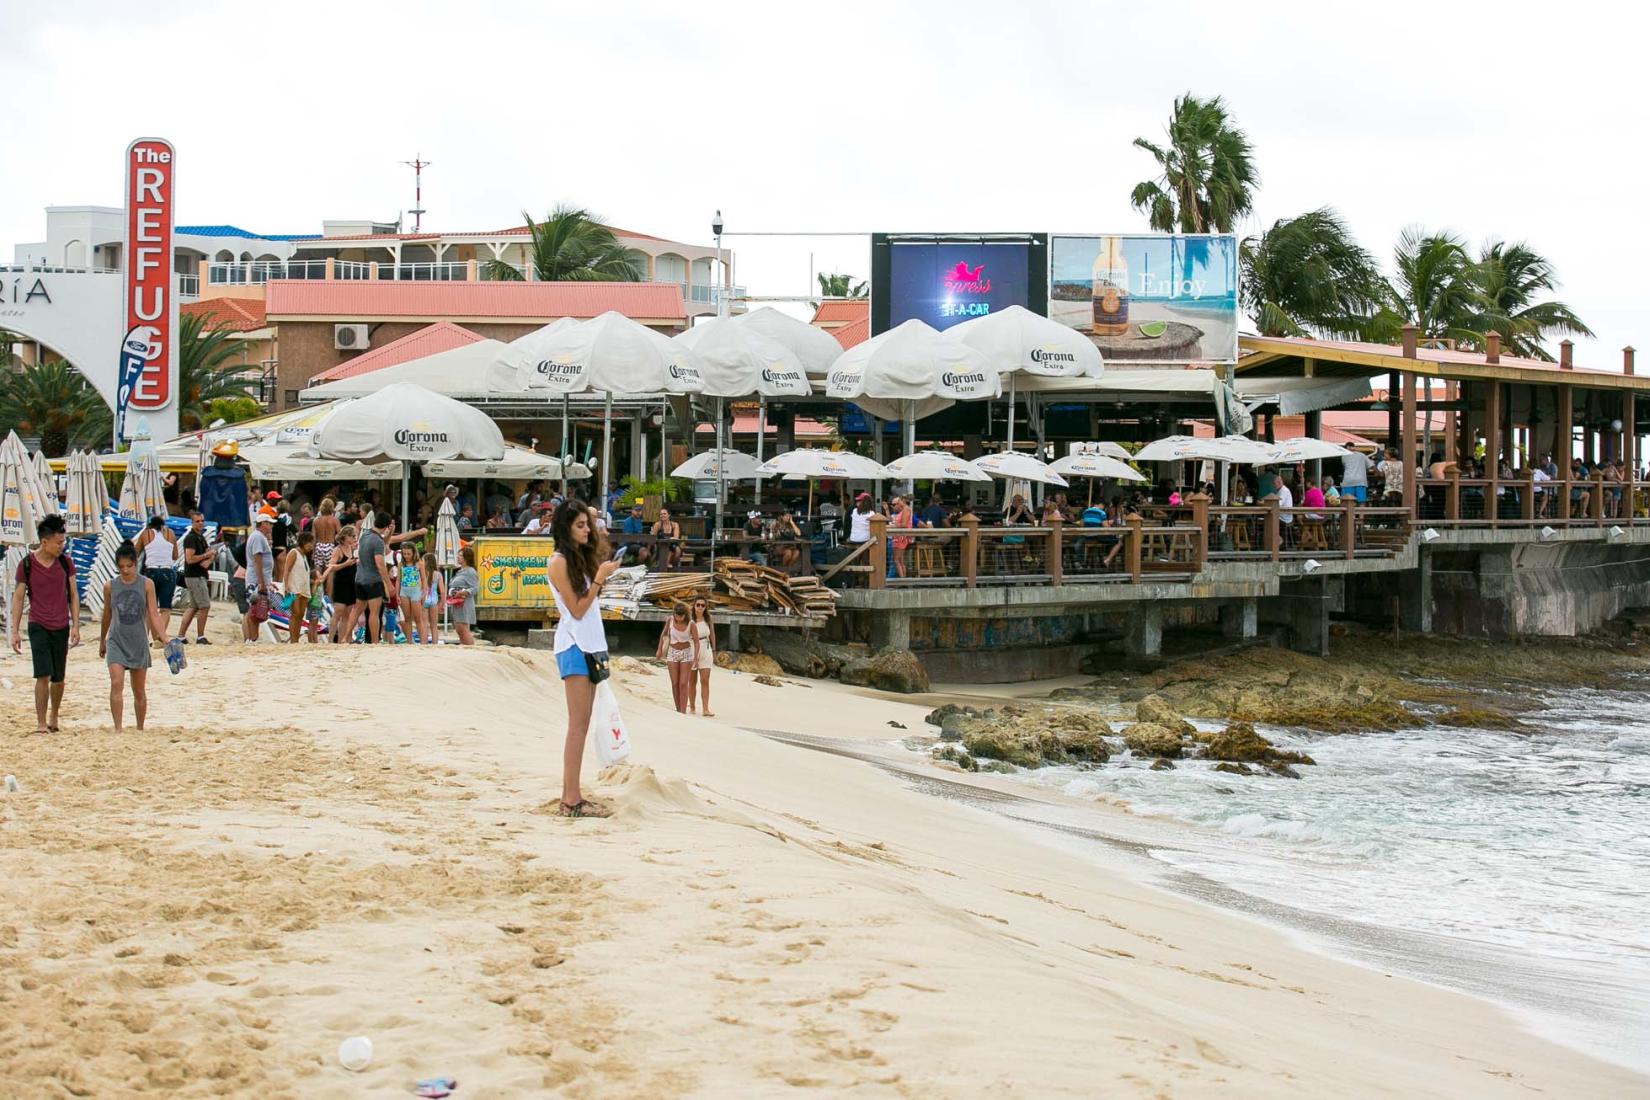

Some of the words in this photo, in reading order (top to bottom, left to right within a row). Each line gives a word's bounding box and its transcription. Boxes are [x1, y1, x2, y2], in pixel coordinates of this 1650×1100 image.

[133, 147, 171, 163] The
[134, 167, 166, 401] REFUGE
[1030, 348, 1075, 363] Corona
[537, 359, 583, 375] Corona
[668, 364, 701, 380] Corona
[1043, 361, 1065, 370] Extra
[548, 374, 571, 384] Extra
[682, 377, 698, 385] Extra
[761, 368, 801, 383] Corona
[831, 371, 861, 385] Corona
[941, 370, 985, 387] Corona
[775, 380, 795, 389] Extra
[836, 382, 852, 393] Extra
[954, 384, 976, 393] Extra
[394, 428, 448, 447] Corona
[409, 442, 434, 453] Extra
